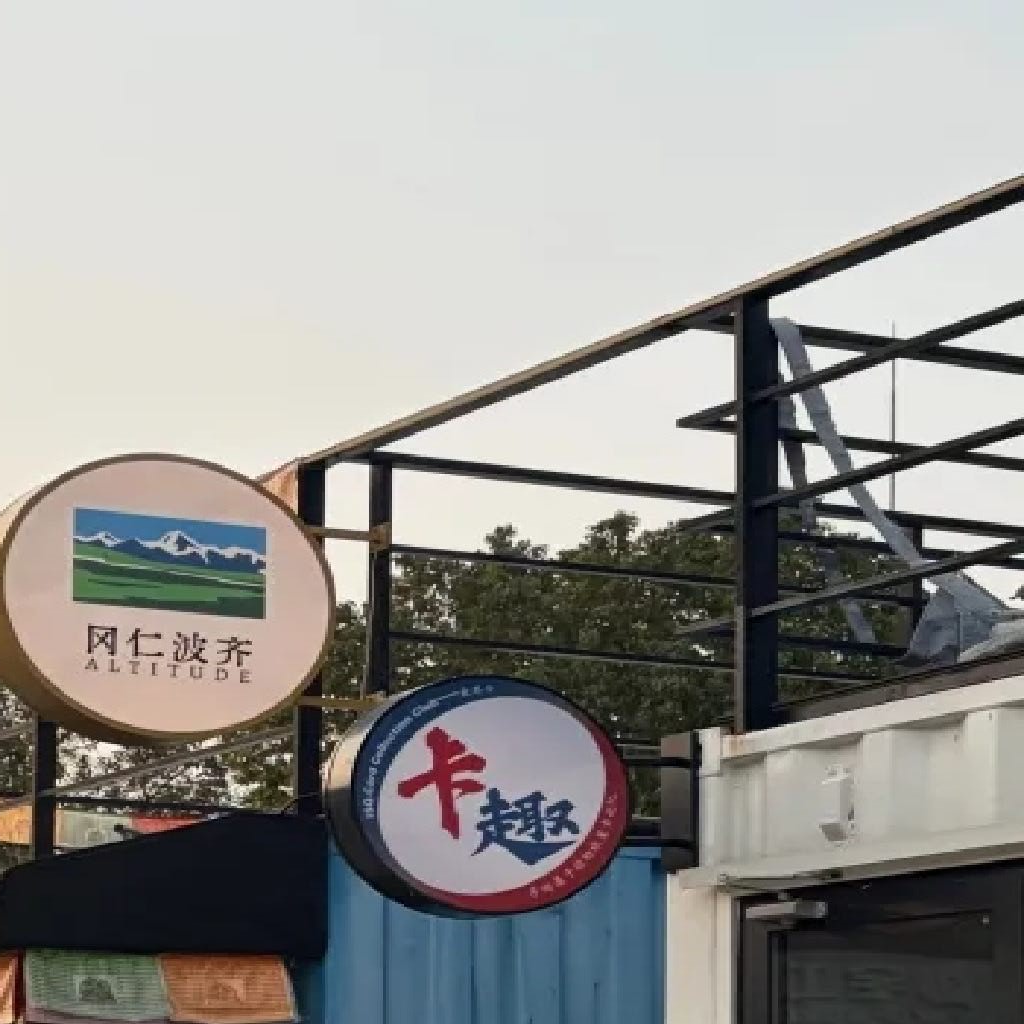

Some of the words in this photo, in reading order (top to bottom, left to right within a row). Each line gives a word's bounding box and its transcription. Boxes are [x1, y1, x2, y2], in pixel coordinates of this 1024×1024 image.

[87, 624, 253, 667] 冈仁波齐
[84, 657, 253, 684] ALTITUDE
[397, 726, 581, 866] 卡趣
